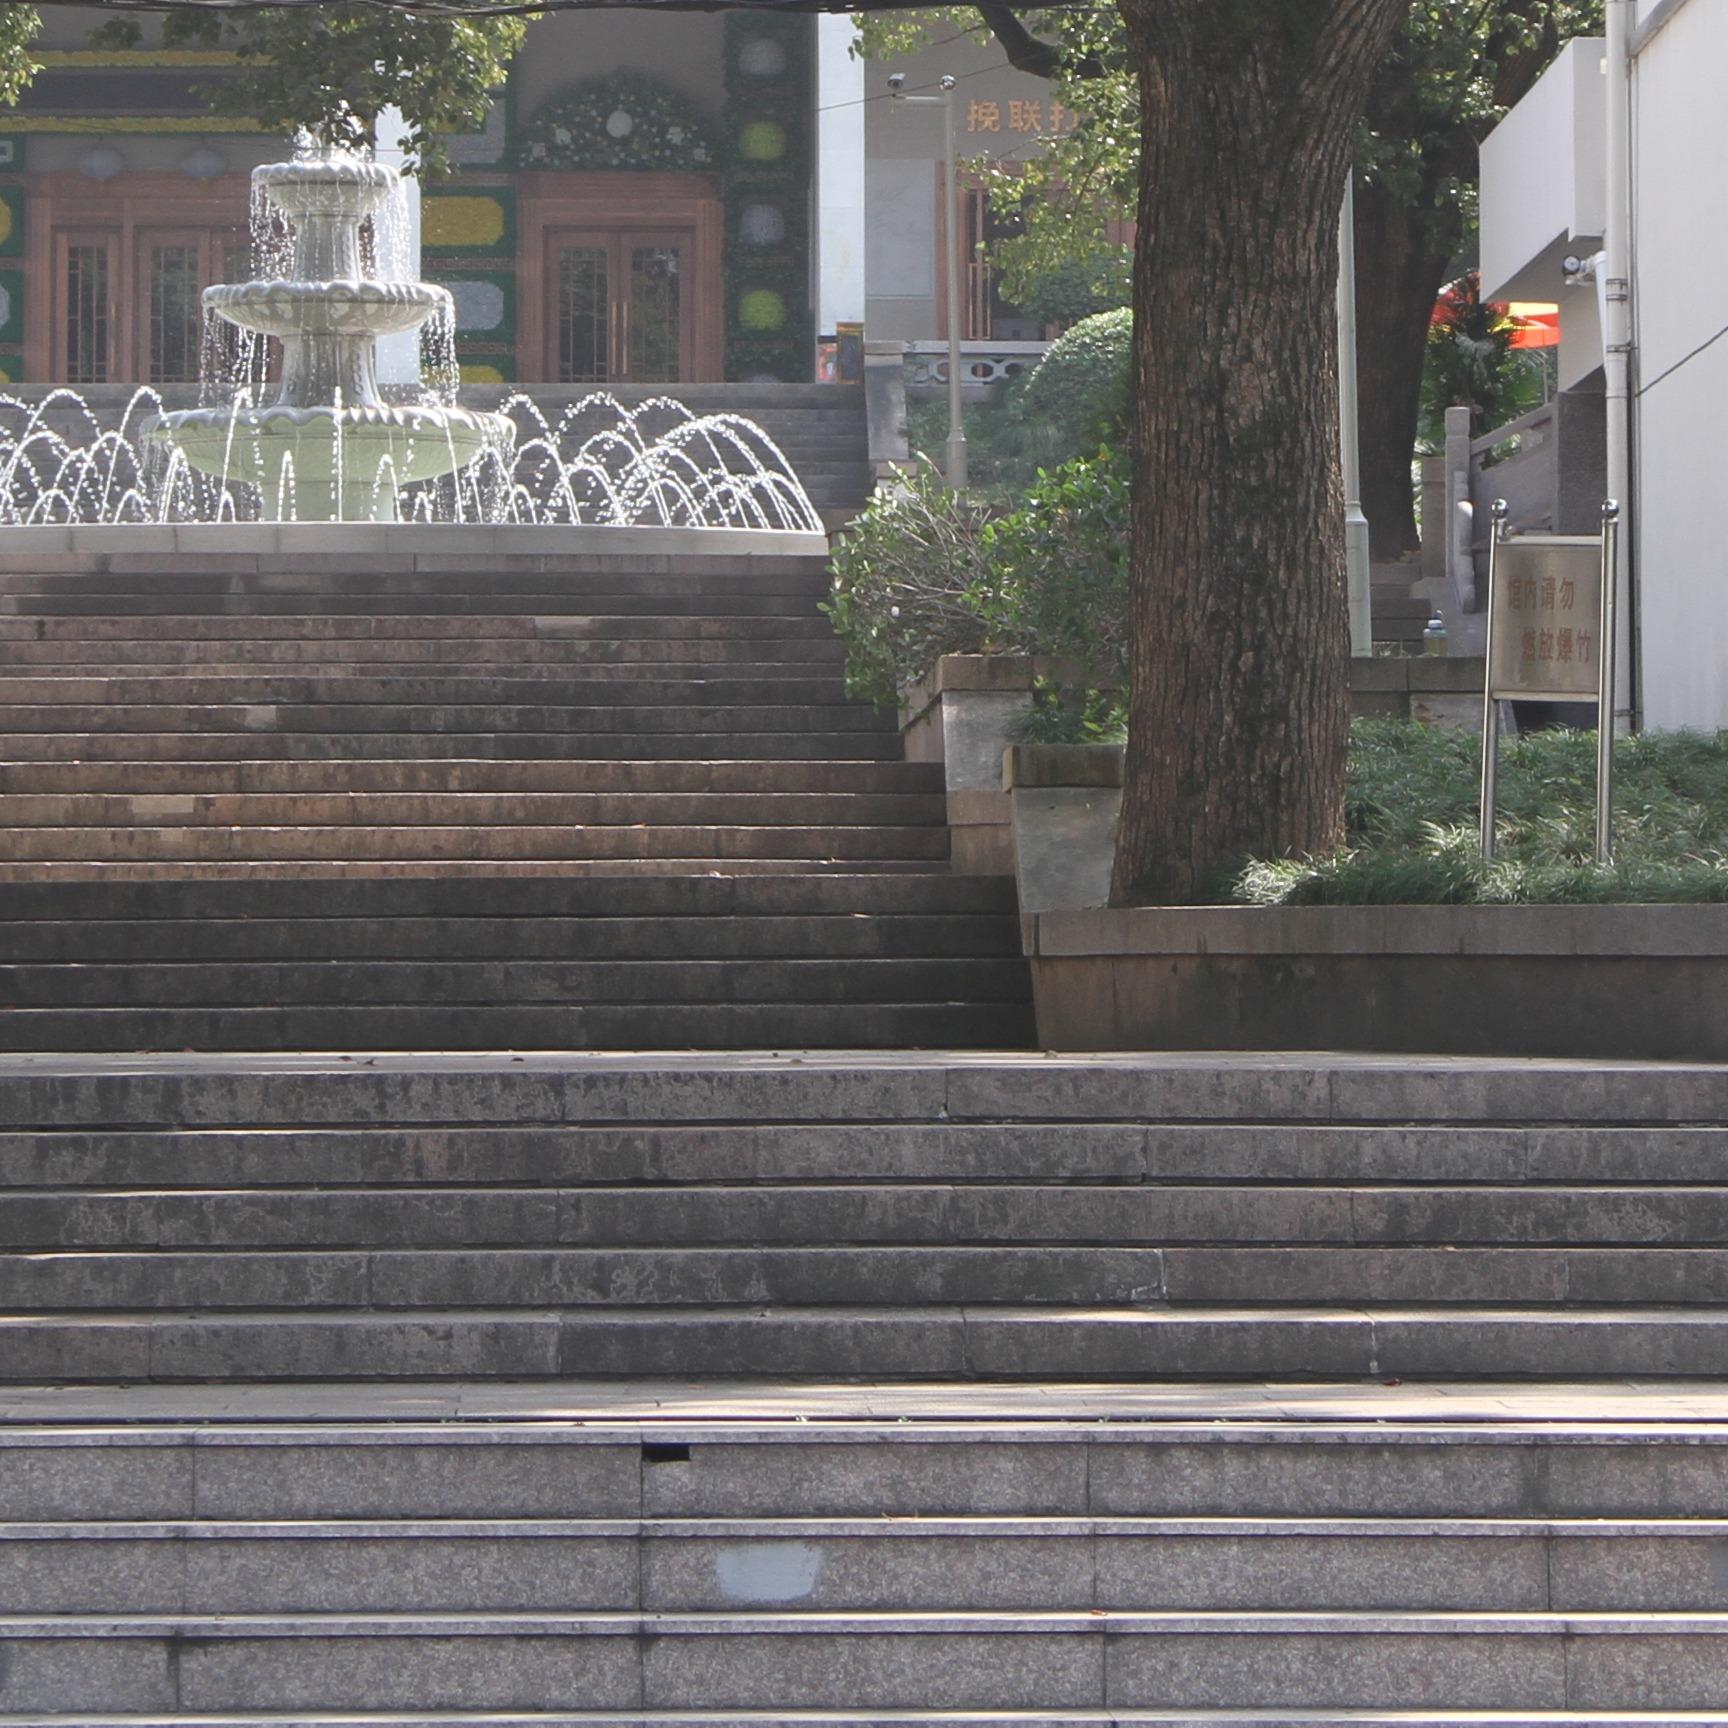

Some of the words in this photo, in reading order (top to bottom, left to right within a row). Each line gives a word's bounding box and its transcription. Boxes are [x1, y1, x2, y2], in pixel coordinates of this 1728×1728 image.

[966, 99, 1095, 133] 挽联打
[1507, 575, 1576, 610] 馆内请勿
